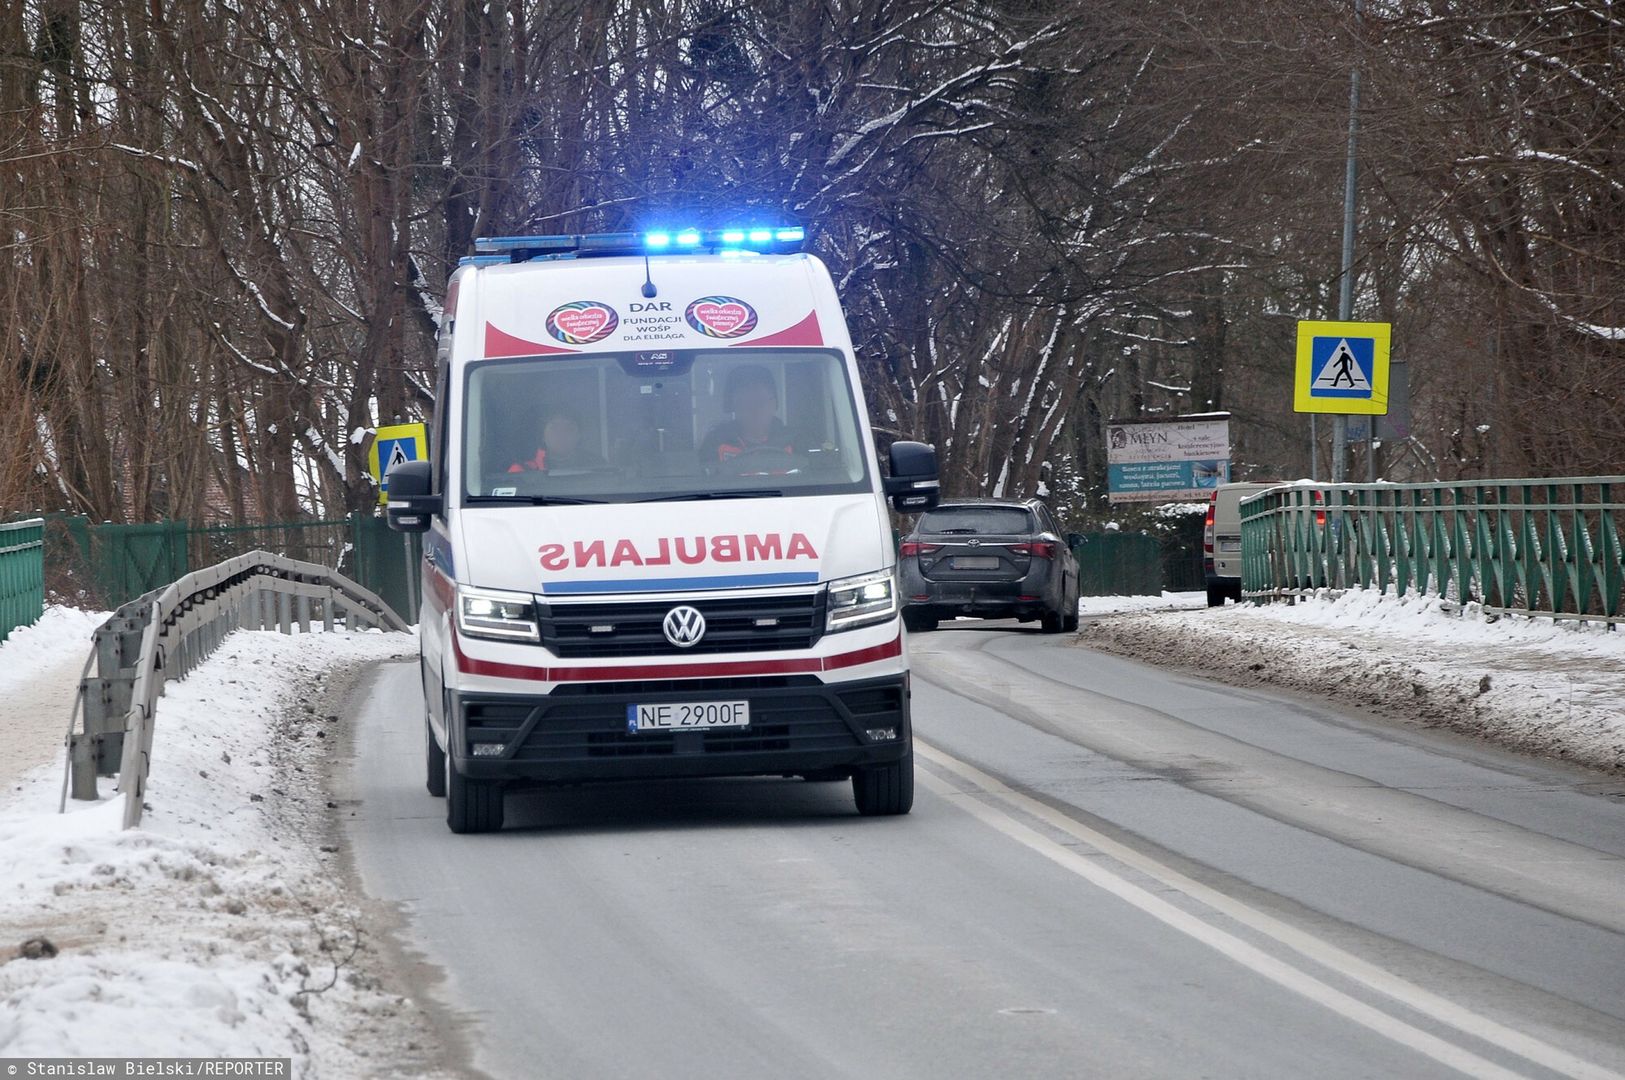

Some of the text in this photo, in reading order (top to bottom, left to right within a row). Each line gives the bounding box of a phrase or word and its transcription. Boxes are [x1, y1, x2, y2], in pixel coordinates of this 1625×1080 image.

[629, 301, 672, 312] DAR
[623, 316, 682, 325] FUNDACJI
[636, 324, 671, 333] WOŚP
[641, 703, 745, 727] NE 2900F
